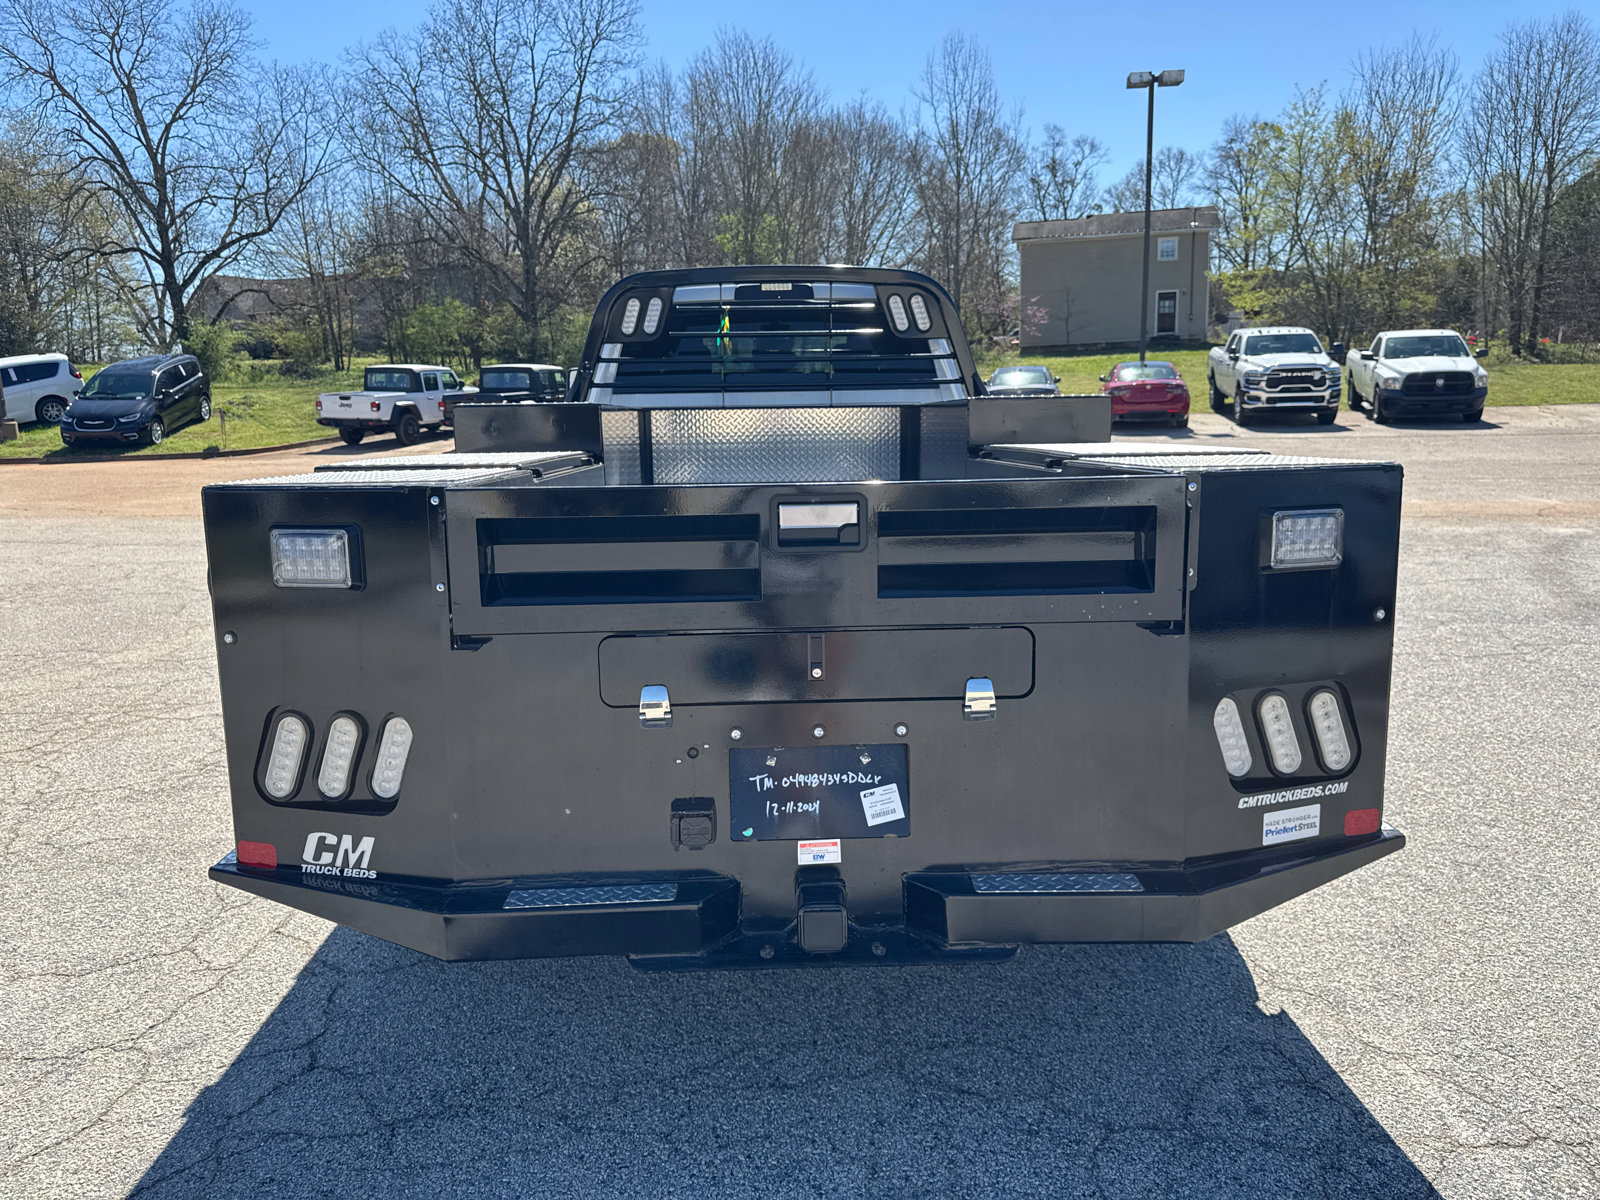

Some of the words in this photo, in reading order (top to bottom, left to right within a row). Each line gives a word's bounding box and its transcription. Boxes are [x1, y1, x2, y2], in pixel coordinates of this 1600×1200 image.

[1237, 781, 1349, 809] CMTRUCKBEDS.COM
[1281, 815, 1311, 824] STRONGER
[302, 831, 376, 869] CM
[301, 863, 341, 877] TRUCK
[343, 867, 377, 879] BEDS
